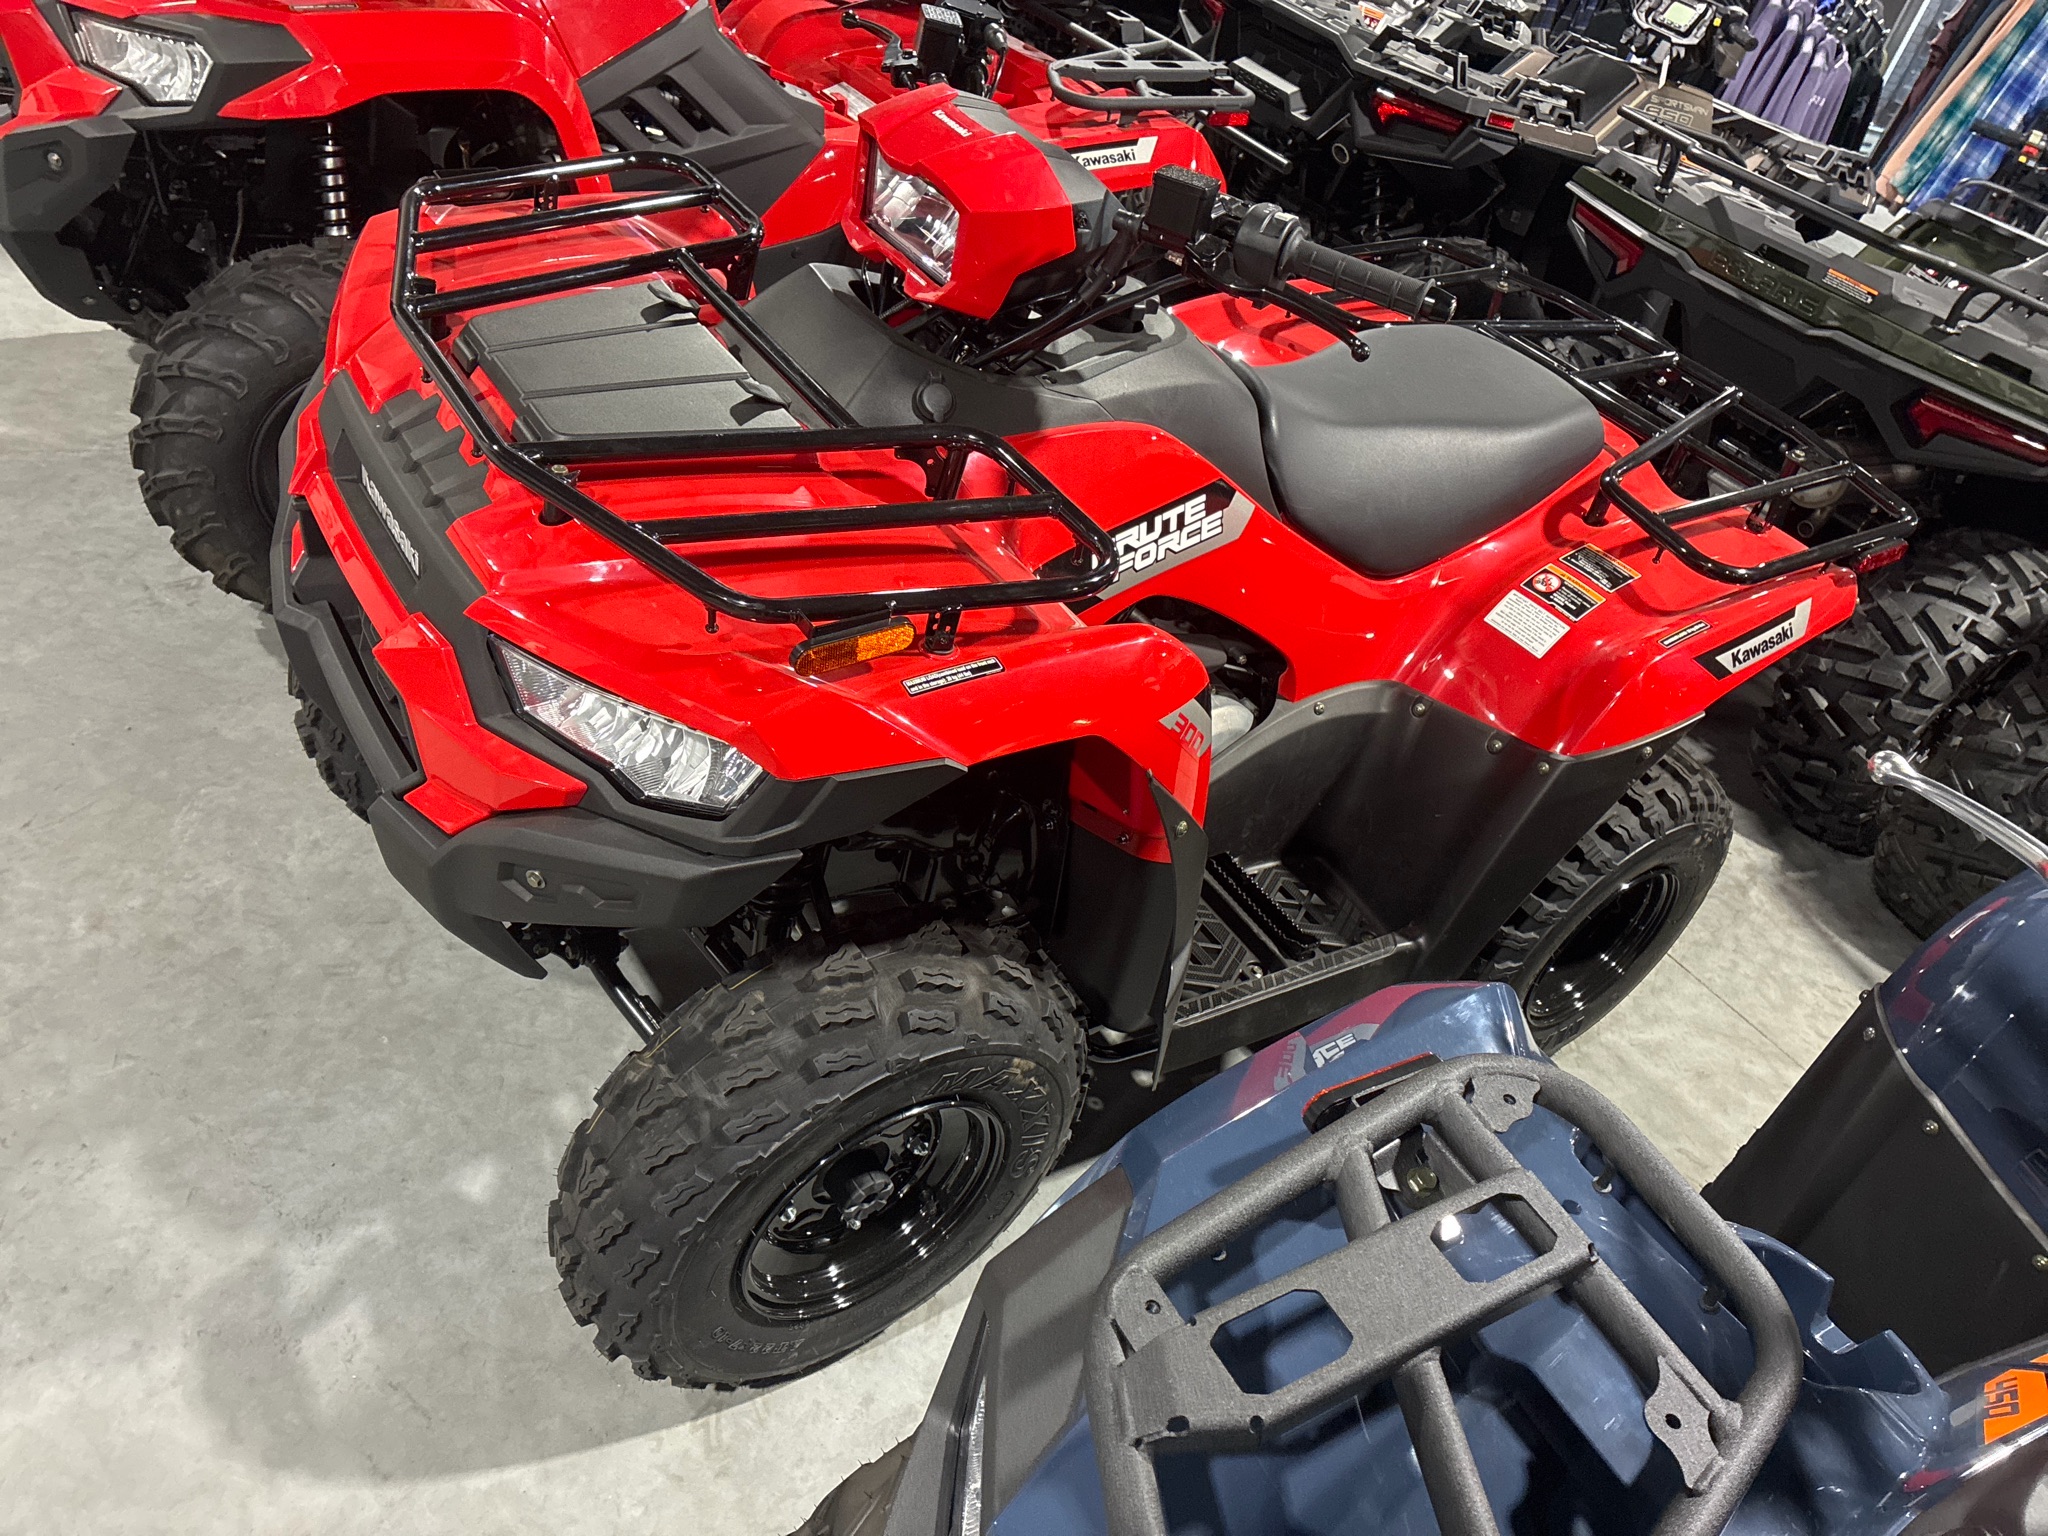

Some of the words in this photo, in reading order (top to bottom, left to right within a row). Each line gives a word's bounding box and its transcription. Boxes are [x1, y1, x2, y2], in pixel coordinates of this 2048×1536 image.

[1650, 94, 1709, 116] SPORTSMAN
[361, 463, 420, 577] Kawasaki
[1092, 494, 1206, 570] RUTE
[1112, 510, 1223, 582] FORCE
[1731, 622, 1794, 669] Kawasaki
[1170, 712, 1205, 757] 300
[922, 1067, 1050, 1179] MAXXIS
[1984, 1377, 2019, 1418] 450
